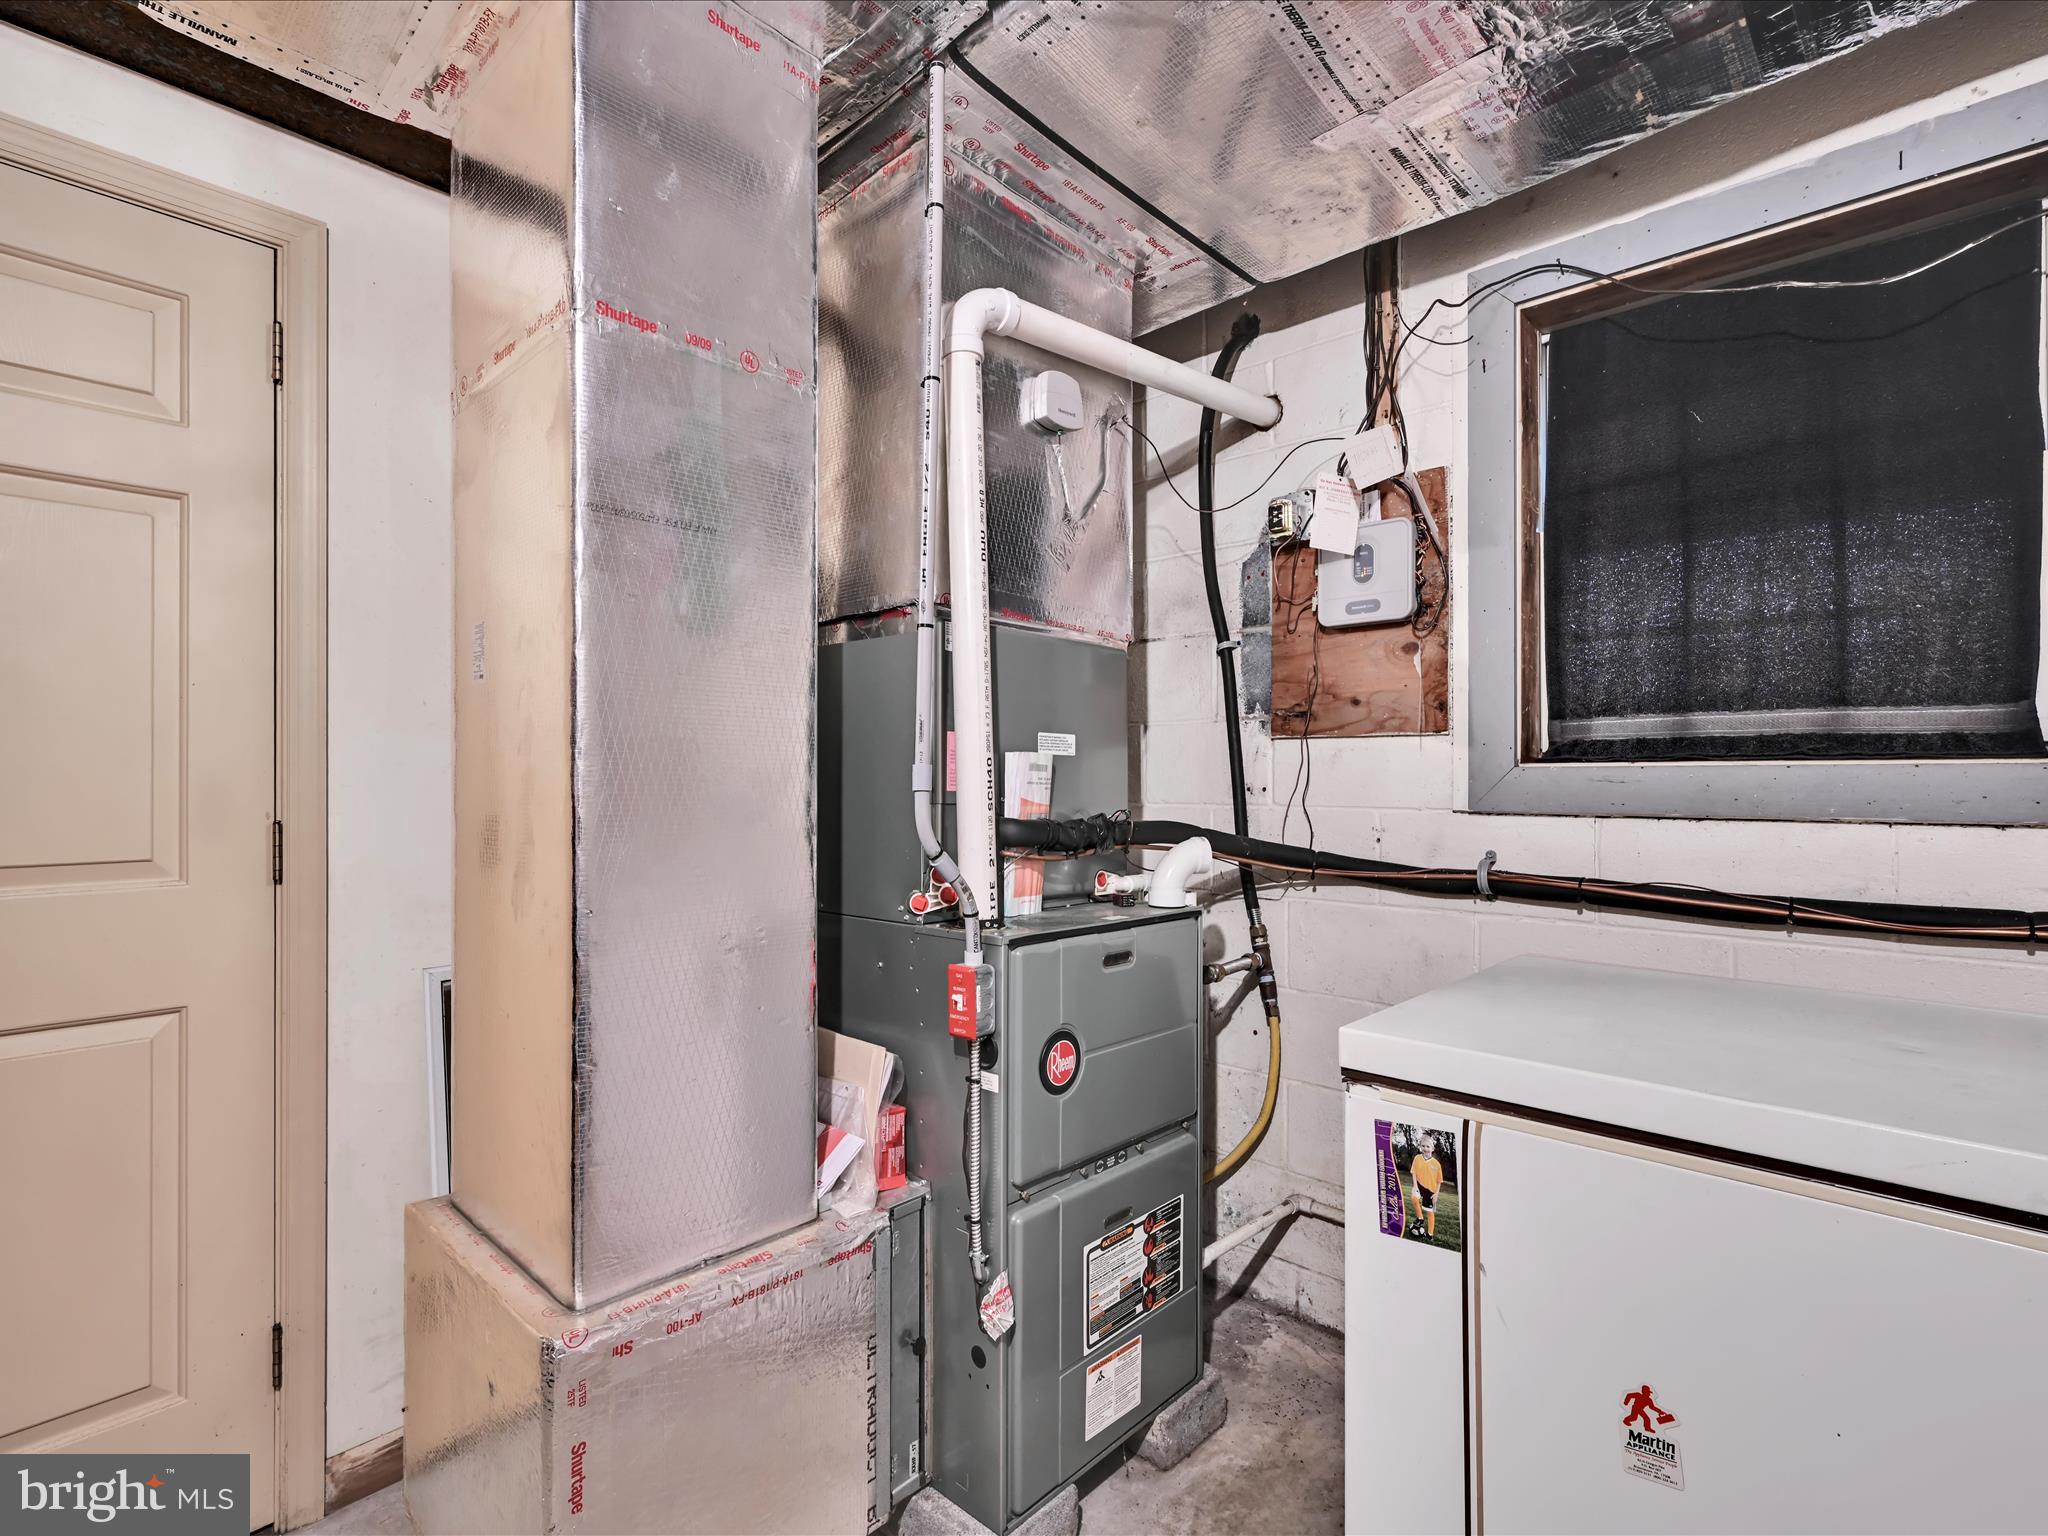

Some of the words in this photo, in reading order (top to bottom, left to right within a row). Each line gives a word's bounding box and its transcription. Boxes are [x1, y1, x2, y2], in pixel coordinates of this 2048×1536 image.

[168, 10, 238, 47] MANVILLE
[708, 8, 761, 52] Shurtape
[1282, 3, 1323, 52] THERM-LOCK
[430, 62, 461, 95] Shurtape
[1013, 142, 1051, 171] Shurtape
[1388, 146, 1415, 172] MANVILLE
[1115, 216, 1138, 232] AF-100
[1144, 235, 1174, 258] Shurtape
[594, 300, 659, 335] Shurtape
[685, 333, 713, 352] 09/09
[986, 757, 994, 812] SCH40
[1050, 1042, 1075, 1080] Rheem
[828, 1240, 873, 1266] Shurtape
[731, 1269, 804, 1307] 181A-P/181B-FX
[667, 1311, 703, 1335] AF-100
[567, 1388, 576, 1408] 25TF
[578, 1378, 587, 1408] LISTED
[1626, 1441, 1676, 1460] APPLIANCE
[1629, 1429, 1676, 1455] Martin
[568, 1441, 587, 1515] Shurtape
